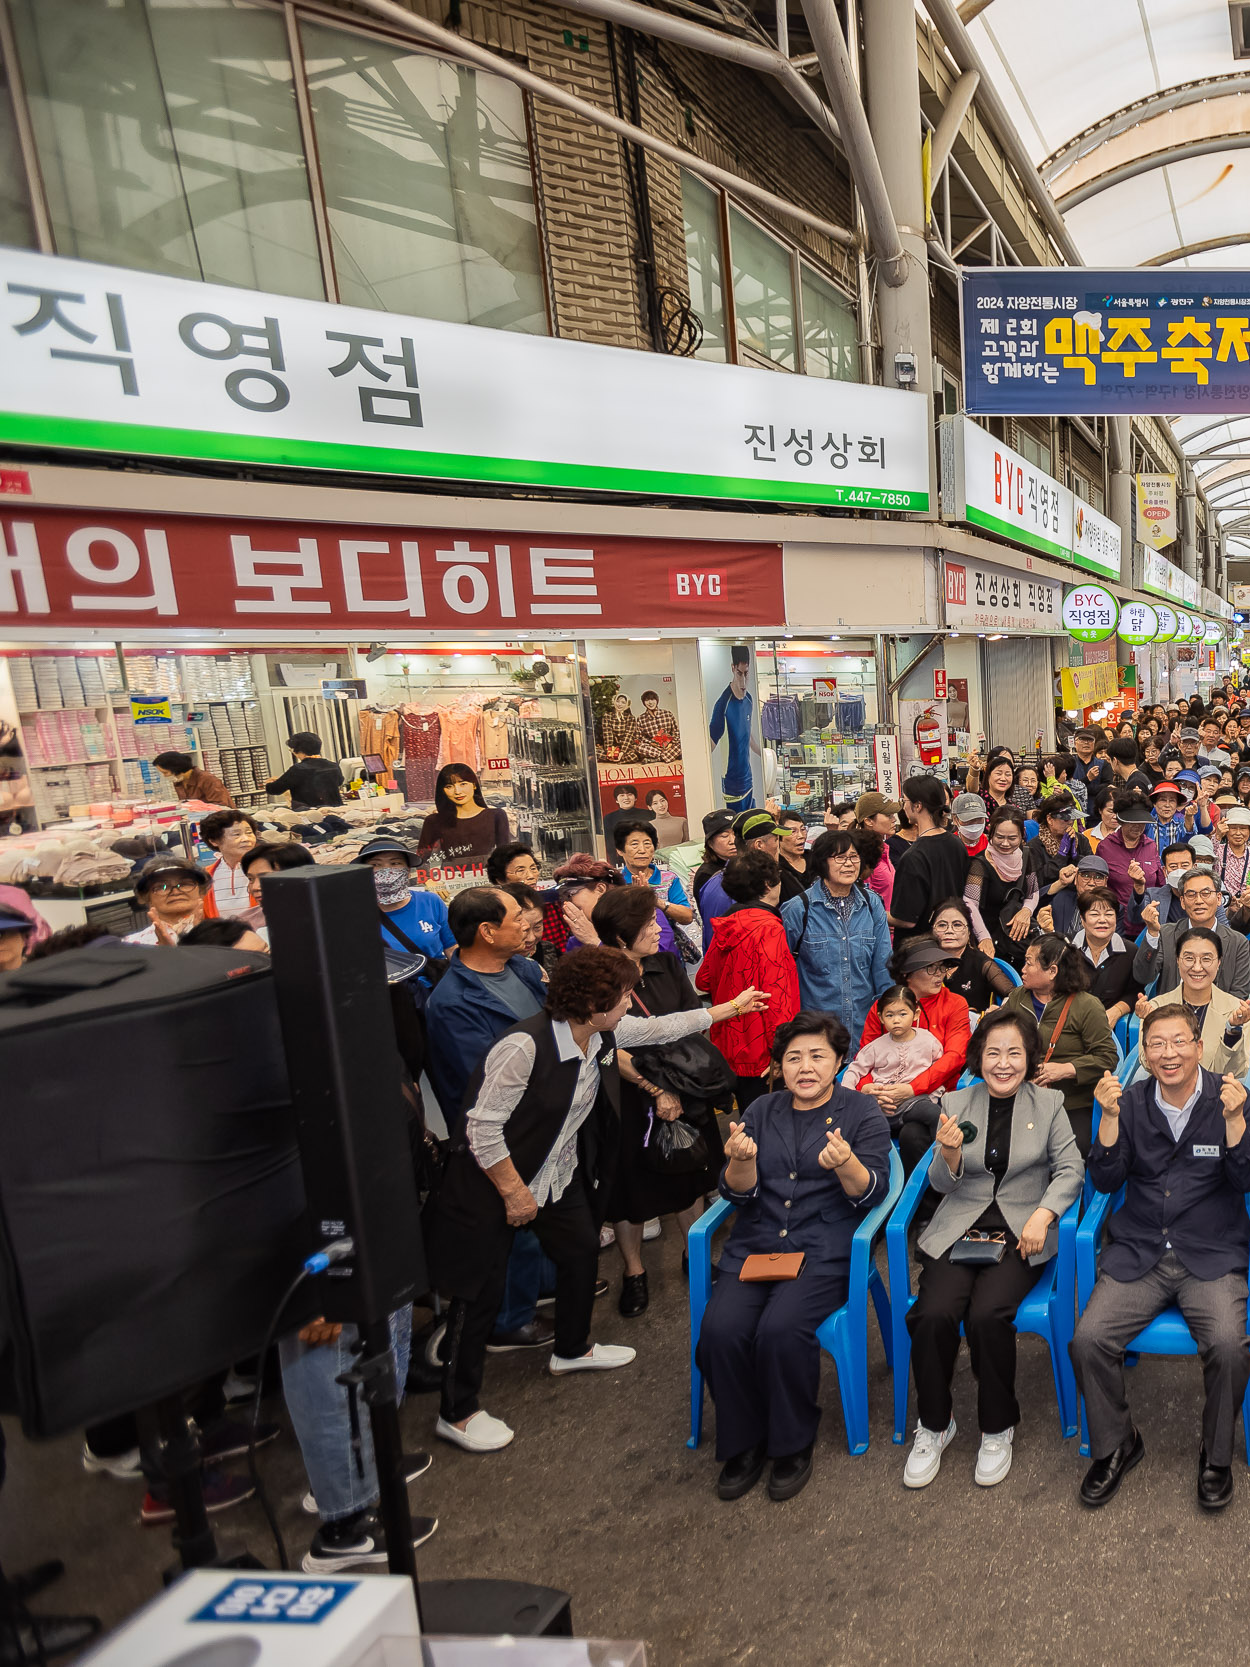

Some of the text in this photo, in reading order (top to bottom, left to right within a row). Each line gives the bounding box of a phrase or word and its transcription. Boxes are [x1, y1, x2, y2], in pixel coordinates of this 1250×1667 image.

[977, 296, 1078, 310] 2024 자양전통시장
[1113, 297, 1149, 308] 서울특별시
[980, 318, 1037, 336] 제 2회
[8, 281, 424, 428] 직영점
[981, 341, 1038, 361] 고객과
[1044, 311, 1158, 385] 맥주
[981, 362, 1059, 384] 함께하는
[744, 424, 886, 469] 진성상회
[836, 489, 911, 506] T.447-7850
[995, 451, 1059, 534] BYC 직영점
[230, 534, 602, 618] 보디히트
[676, 574, 721, 596] BYC
[948, 570, 965, 600] BYC
[975, 572, 1053, 613] 진성상회 직영점
[1075, 594, 1103, 606] BYC
[1069, 610, 1110, 625] 직영점
[1129, 608, 1145, 618] 하림
[1081, 630, 1097, 638] 속옷
[1132, 619, 1143, 631] 닭
[138, 708, 164, 716] NSOK
[488, 760, 508, 768] BYC
[599, 765, 683, 780] HOME WEAR
[881, 740, 892, 793] 타월 맞춤
[416, 864, 467, 884] BODY
[215, 1585, 335, 1616] 응모함
